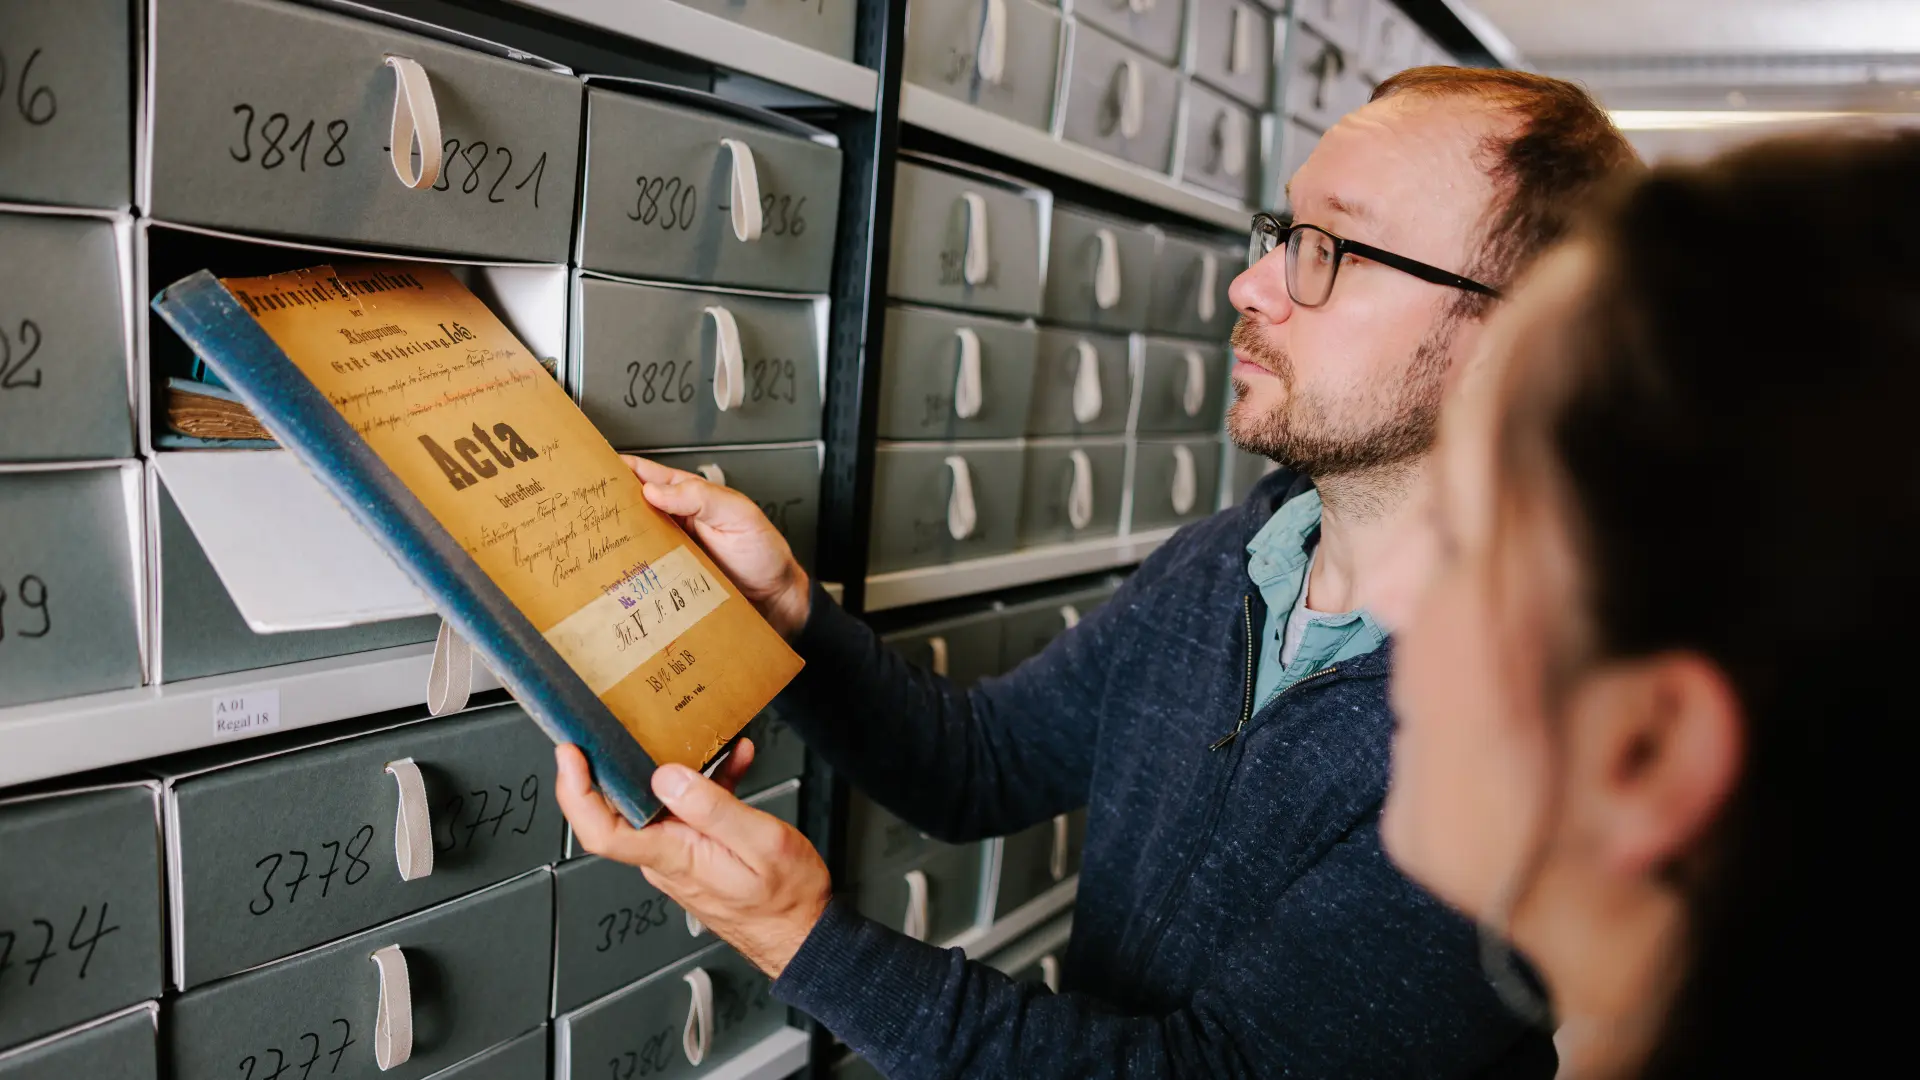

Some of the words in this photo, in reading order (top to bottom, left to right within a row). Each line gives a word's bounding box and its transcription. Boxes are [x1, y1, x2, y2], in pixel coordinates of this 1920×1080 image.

[0, 48, 56, 126] 6
[229, 104, 349, 172] 3818
[432, 138, 548, 209] 3821
[627, 176, 697, 231] 3830
[761, 192, 808, 238] 836
[0, 319, 42, 389] 2
[623, 360, 696, 408] 3826
[744, 358, 797, 405] 829
[417, 422, 540, 492] Acta
[494, 478, 546, 509] betreffend:
[0, 574, 51, 643] 9
[629, 569, 663, 601] 3817
[669, 588, 686, 612] 13
[670, 656, 688, 676] bis
[683, 649, 697, 666] 18
[217, 701, 227, 715] A
[230, 698, 244, 712] 01
[217, 714, 251, 732] Regal
[255, 712, 270, 726] 18
[248, 824, 375, 917] 3778
[438, 774, 540, 852] 3779
